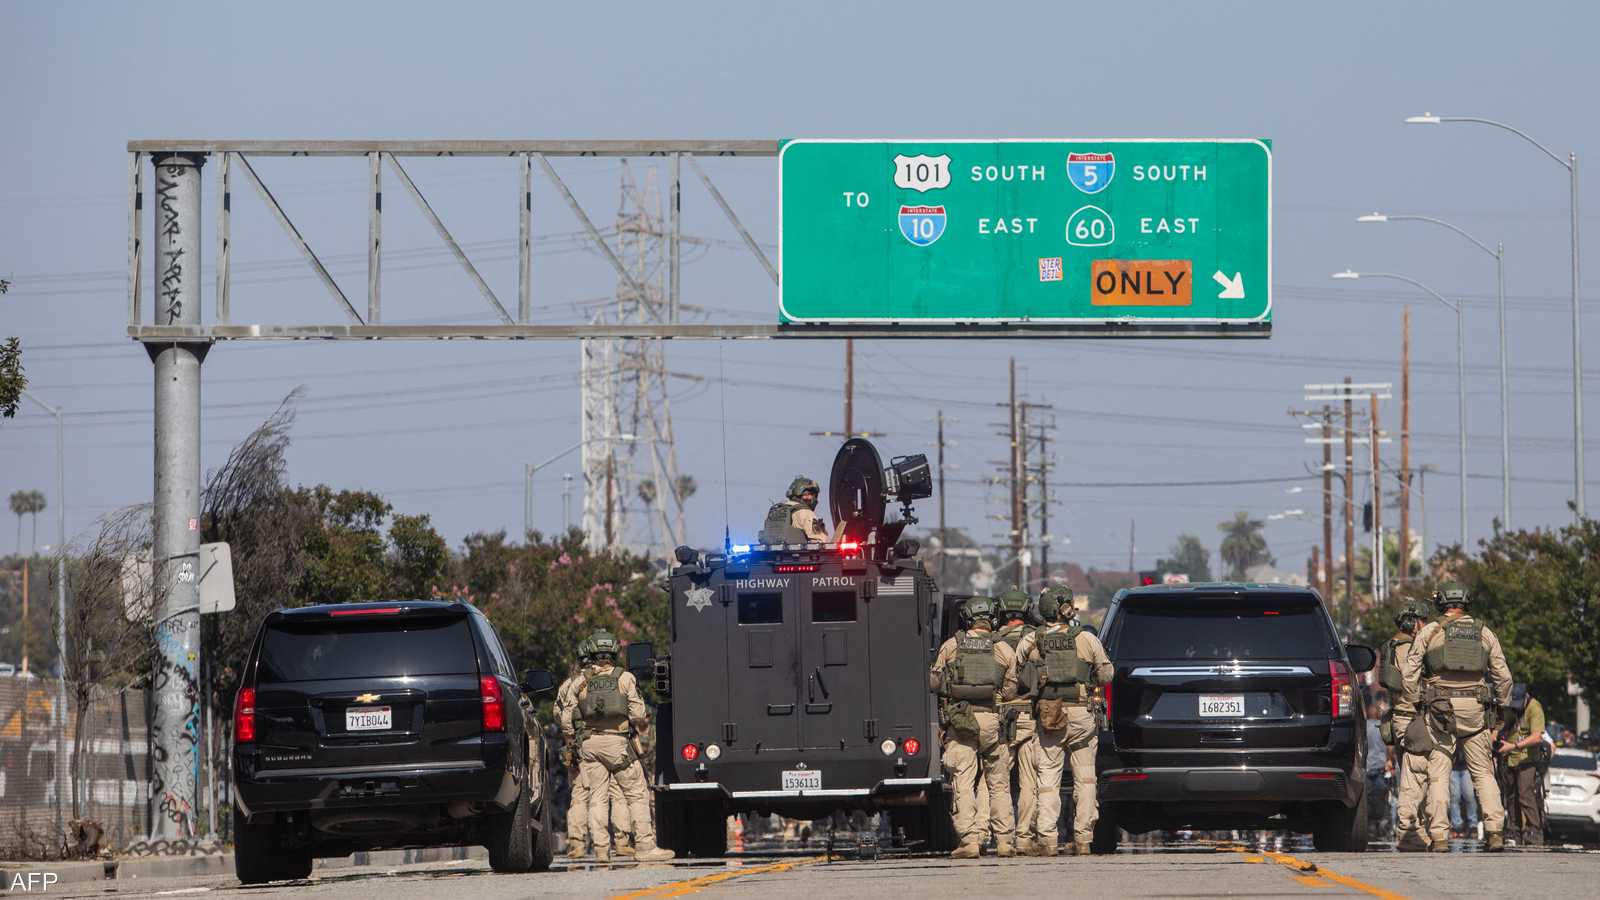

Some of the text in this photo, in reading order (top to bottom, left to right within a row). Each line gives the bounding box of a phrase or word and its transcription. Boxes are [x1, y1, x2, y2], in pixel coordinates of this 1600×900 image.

[905, 163, 1207, 186] 101 SOUTH 5 SOUTH
[843, 192, 870, 208] TO
[911, 217, 1200, 240] 10 EAST 60 EAST
[1096, 271, 1186, 295] ONLY
[736, 576, 856, 589] HIGHWAY PATROL
[1043, 640, 1074, 649] POLICE
[590, 680, 616, 689] POLICE
[1201, 702, 1241, 713] 1682351
[785, 778, 819, 789] 1536113
